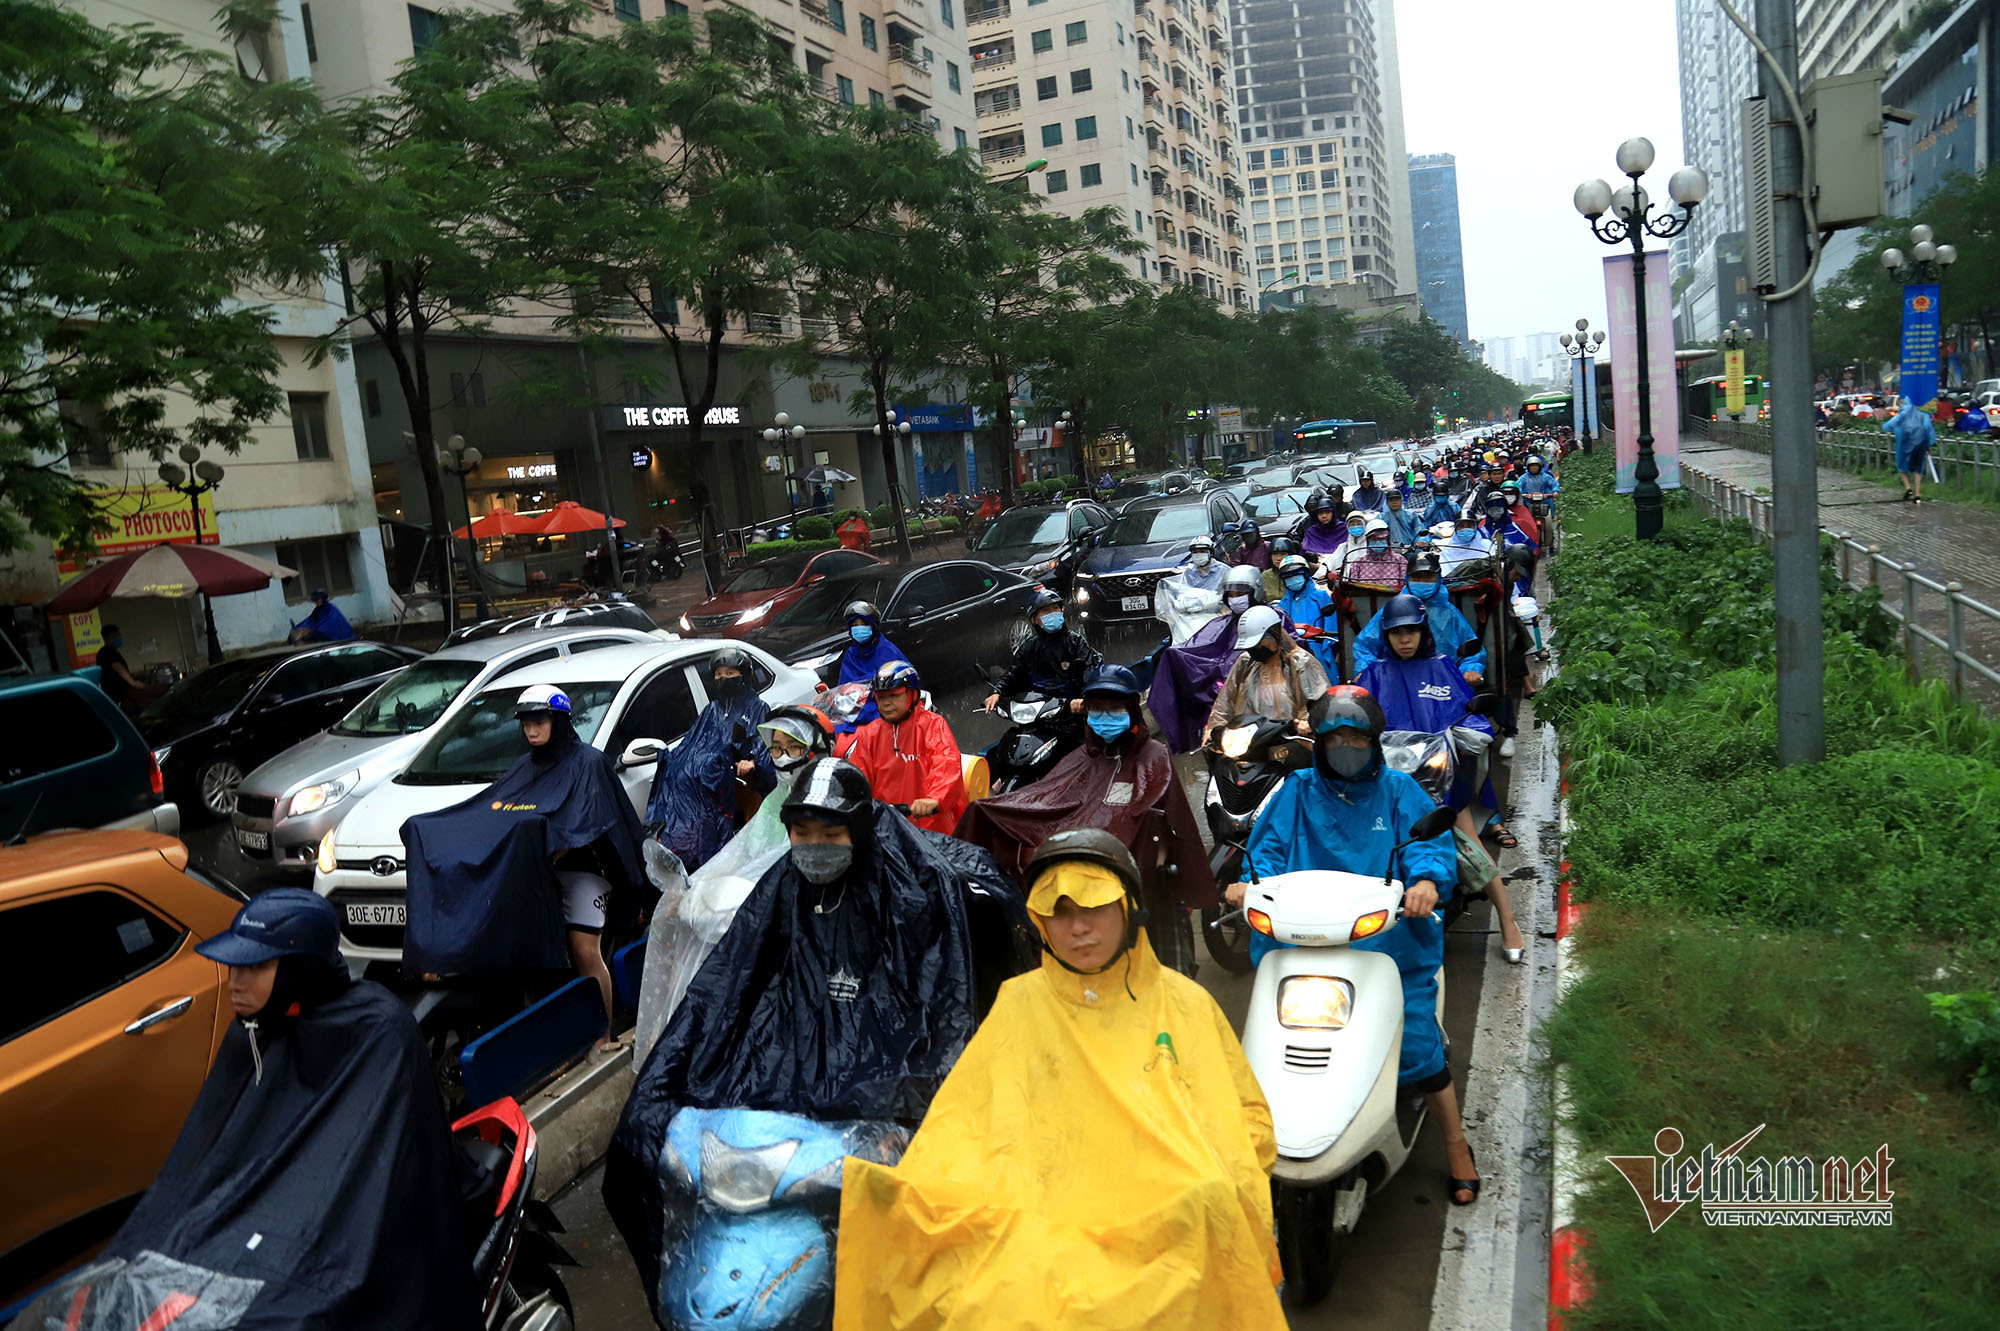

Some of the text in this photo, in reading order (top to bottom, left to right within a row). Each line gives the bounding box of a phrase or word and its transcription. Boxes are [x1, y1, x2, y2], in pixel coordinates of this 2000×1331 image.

[623, 407, 650, 426] THE
[652, 407, 690, 426] COFFE
[507, 466, 525, 479] THE
[73, 614, 94, 627] COPY
[348, 906, 405, 924] 30E-677.8
